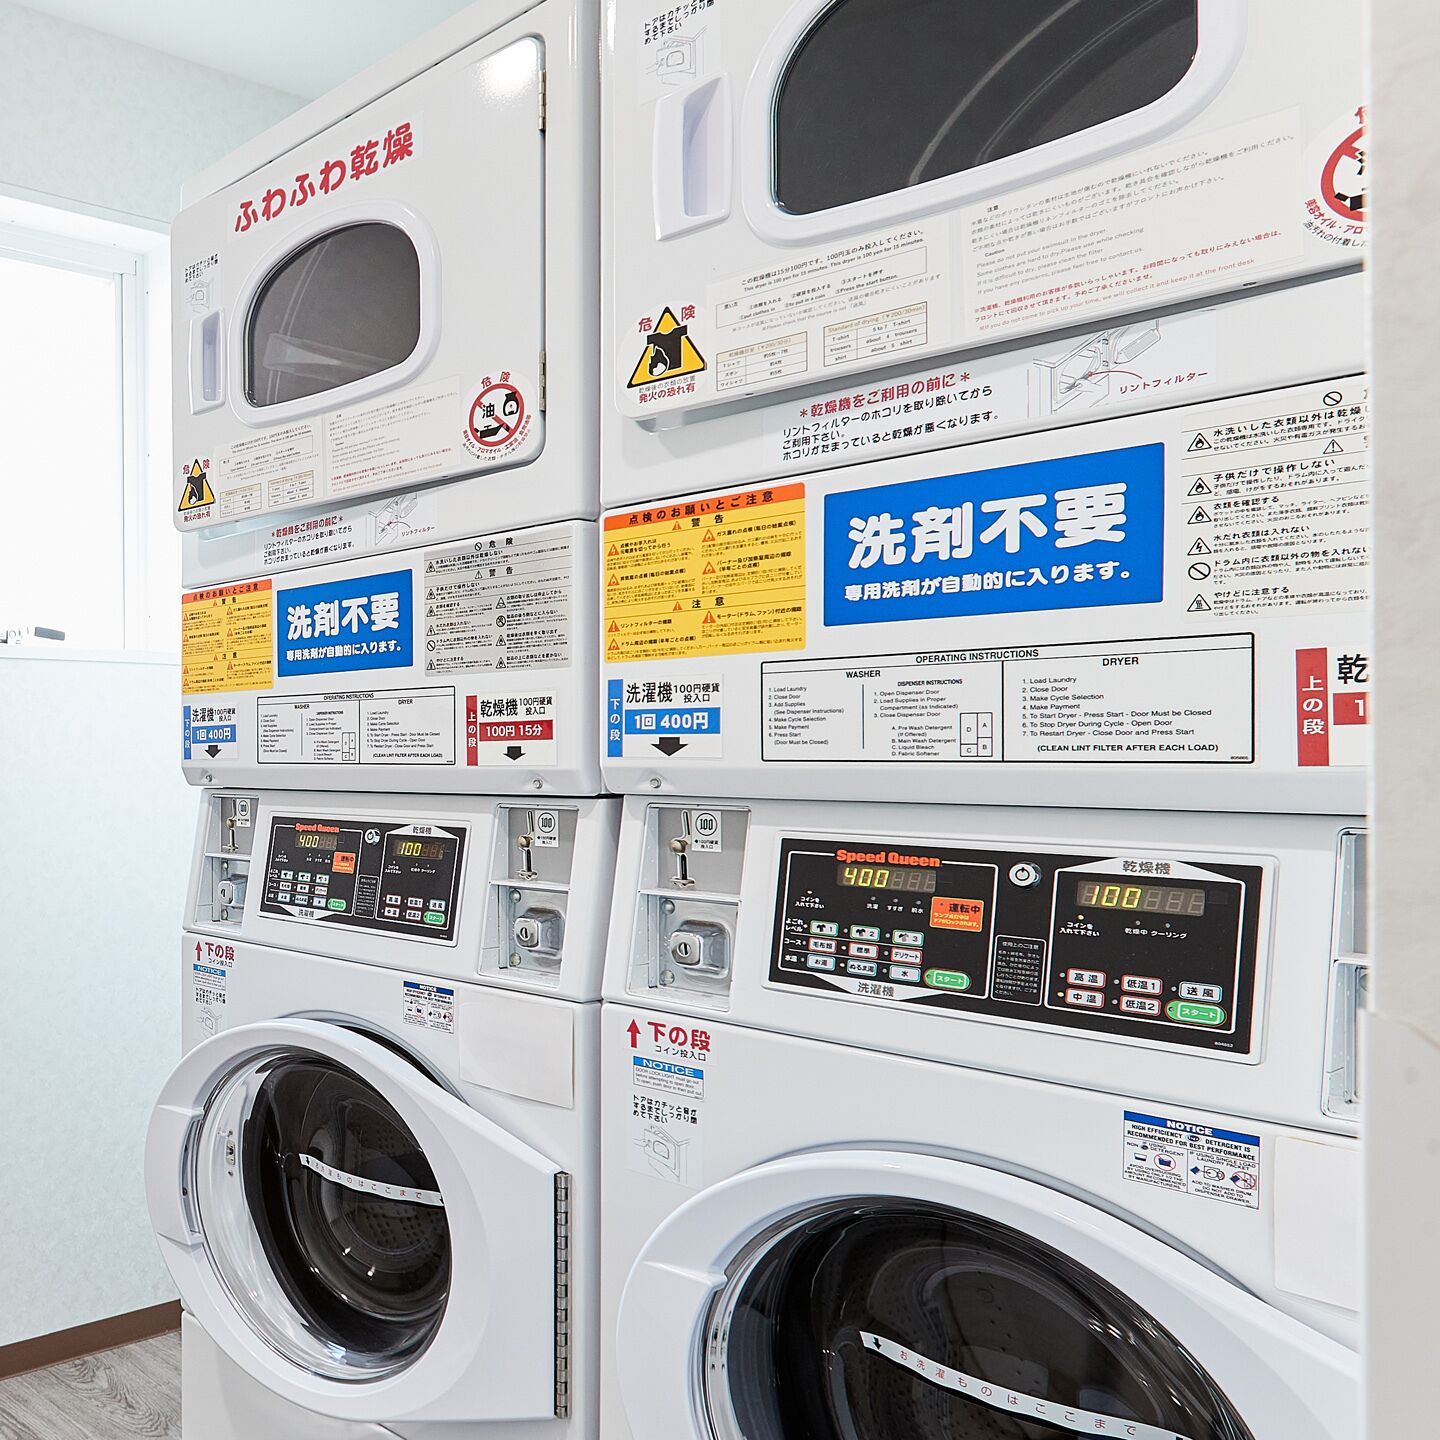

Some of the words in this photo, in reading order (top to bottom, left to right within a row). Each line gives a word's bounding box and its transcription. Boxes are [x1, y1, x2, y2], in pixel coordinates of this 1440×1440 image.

[234, 121, 414, 234] ふわふわ乾燥
[1119, 372, 1209, 395] リントフィルター
[639, 383, 695, 403] 発火の恐れ有
[482, 403, 495, 418] 油
[783, 386, 993, 437] リントフィルターのホコリを取り除いてから
[783, 411, 999, 460] ホコリがたまっていると乾燥が悪くなります。
[783, 431, 845, 449] ご利用下さい。
[1213, 459, 1335, 482] 子供だけで操作しない
[629, 491, 774, 525] 点検のお願いとご注意
[1213, 496, 1279, 510] 衣類を確認する
[691, 515, 724, 527] 警告
[848, 482, 1127, 569] 洗剤不要
[1213, 526, 1309, 542] 水だれ衣類は入れない
[488, 537, 513, 548] 危険
[844, 560, 1131, 602] 専用洗剤が自動的に入ります。
[1214, 587, 1289, 598] やけどに注意する
[692, 597, 724, 608] 注意
[287, 591, 400, 641] 洗剤不要
[286, 639, 404, 662] 専用洗剤が自動的に入ります。
[915, 654, 967, 664] OPERATING
[969, 649, 1039, 661] INSTRUCTIONS
[1102, 657, 1139, 666] DRYER
[846, 670, 881, 678] WASHER
[627, 682, 672, 703] 洗濯機
[674, 683, 720, 693] 100円硬貨
[519, 696, 552, 706] 100円硬貨
[684, 694, 710, 703] 投入口
[1302, 675, 1325, 734] 上の段
[480, 698, 518, 718] 乾燥機
[526, 706, 545, 715] 投入口
[610, 699, 620, 740] 下の段
[635, 714, 656, 730] 1回
[660, 712, 708, 730] 400円
[468, 712, 476, 747] 上の段
[486, 726, 515, 736] 100円
[519, 724, 542, 735] 15分
[1188, 744, 1219, 752] LOAD)
[295, 823, 317, 831] Speed
[318, 824, 340, 833] Queen
[541, 818, 552, 828] 100
[700, 819, 713, 830] 100
[300, 835, 319, 847] 400
[401, 842, 422, 856] 100
[837, 849, 886, 864] Speed
[888, 852, 942, 867] Queen
[1122, 860, 1171, 874] 乾燥機
[844, 868, 889, 888] 400
[1091, 885, 1142, 909] 100
[949, 903, 980, 914] 運転中
[1059, 927, 1100, 937] 入れて下さい
[1067, 921, 1094, 929] コインを
[1151, 930, 1187, 938] クーリング
[205, 942, 234, 961] 下の段
[894, 952, 919, 960] デリケート
[197, 965, 222, 975] NOTICE
[208, 958, 232, 967] コイン投入口
[937, 975, 964, 984] スタート
[858, 981, 894, 997] 洗濯機
[1182, 1008, 1216, 1017] スタート
[648, 1021, 710, 1052] 下の段
[656, 1045, 706, 1061] コイン投入口
[643, 1059, 694, 1076] NOTICE
[1166, 1120, 1213, 1135] NOTICE
[1128, 1130, 1173, 1144] RECOMMENDED
[1207, 1147, 1255, 1161] PERFORMANCE
[1147, 1127, 1182, 1138] EFFICIENCY
[1205, 1139, 1242, 1150] DETERGENT
[900, 1350, 1137, 1436] お洗濯ものはここまで
